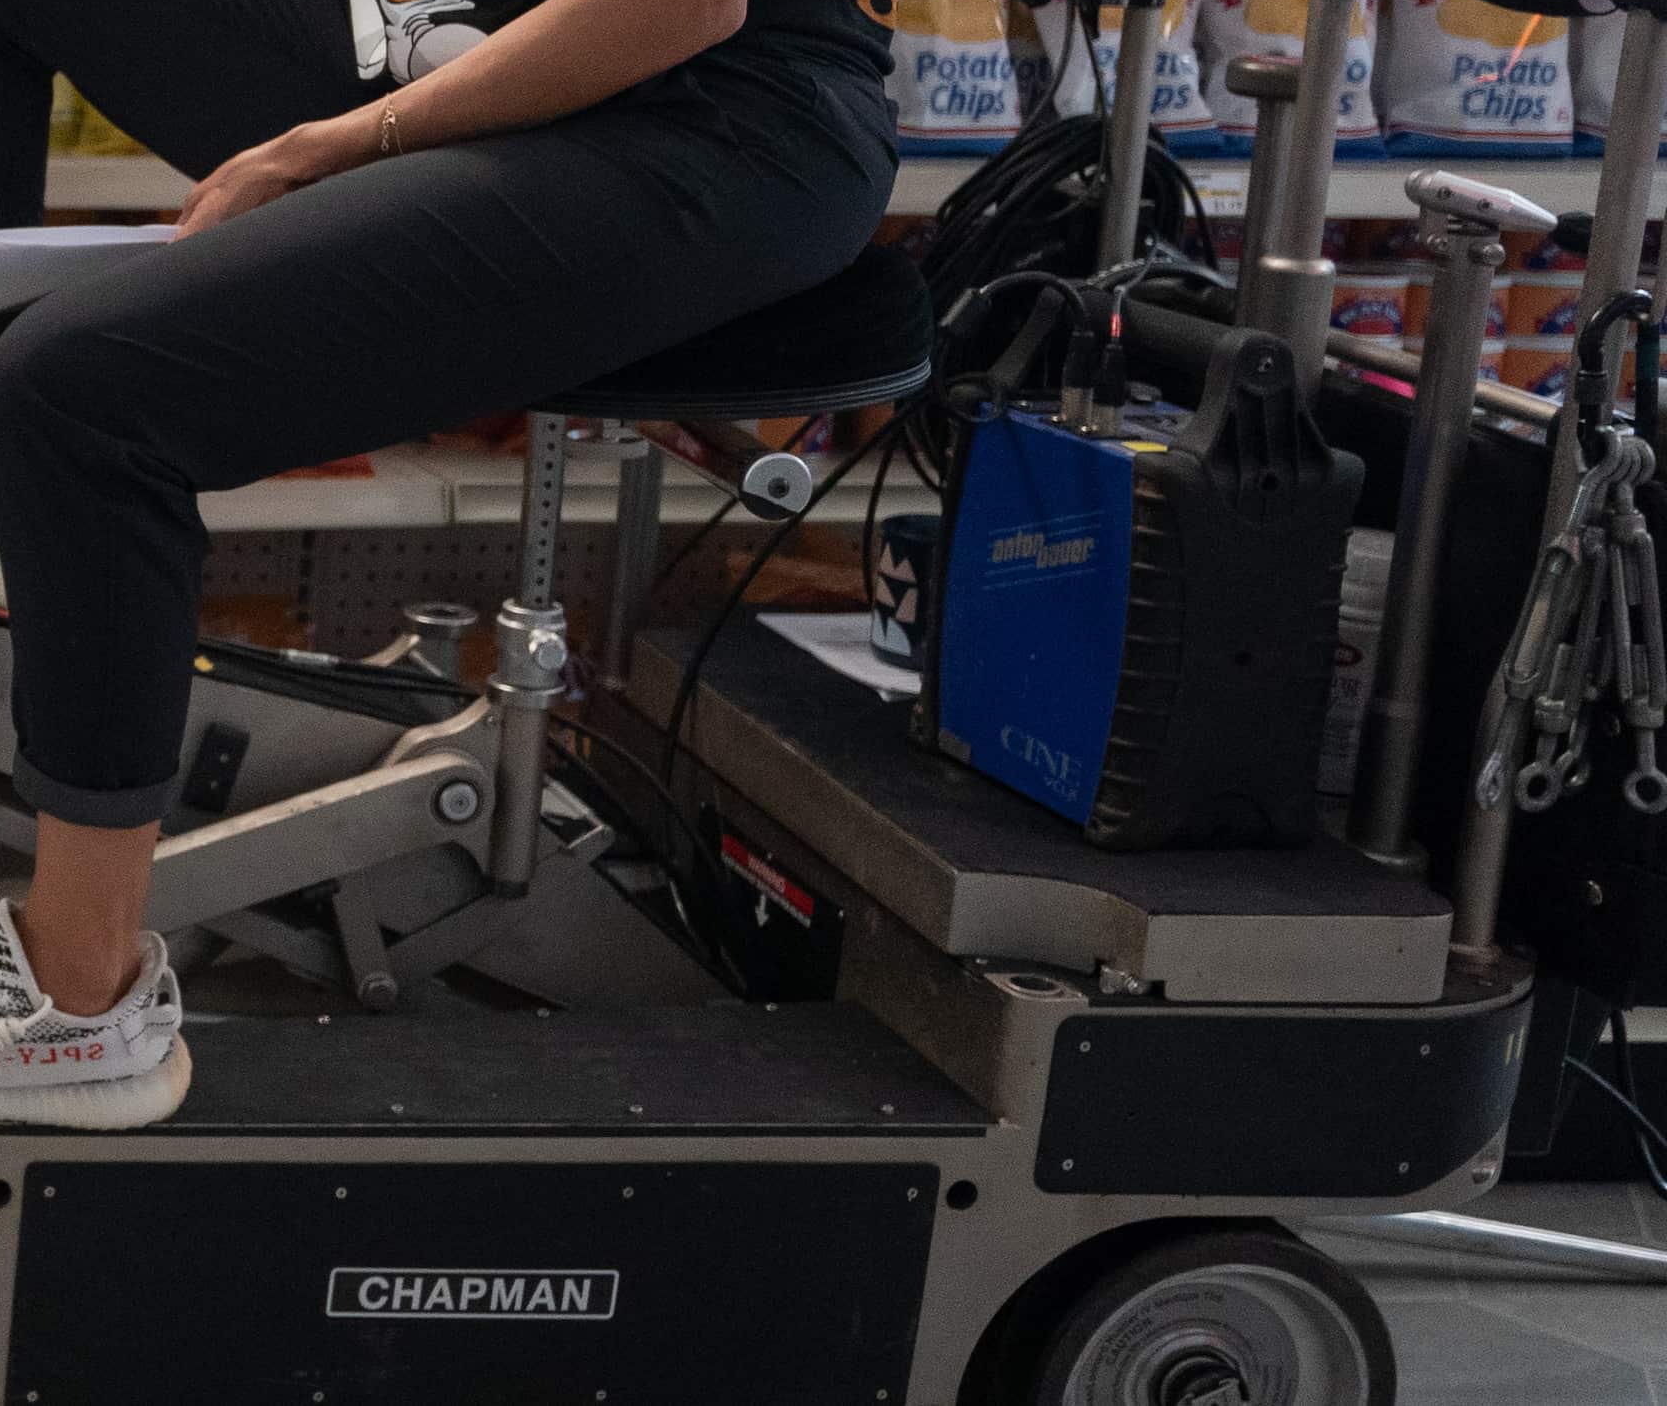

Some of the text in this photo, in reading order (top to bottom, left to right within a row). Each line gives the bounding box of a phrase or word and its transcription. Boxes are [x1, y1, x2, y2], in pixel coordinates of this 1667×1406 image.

[1452, 53, 1558, 87] Potato
[931, 84, 1005, 120] Chips
[1463, 88, 1546, 125] Chips
[358, 1275, 592, 1312] CHAPMAN
